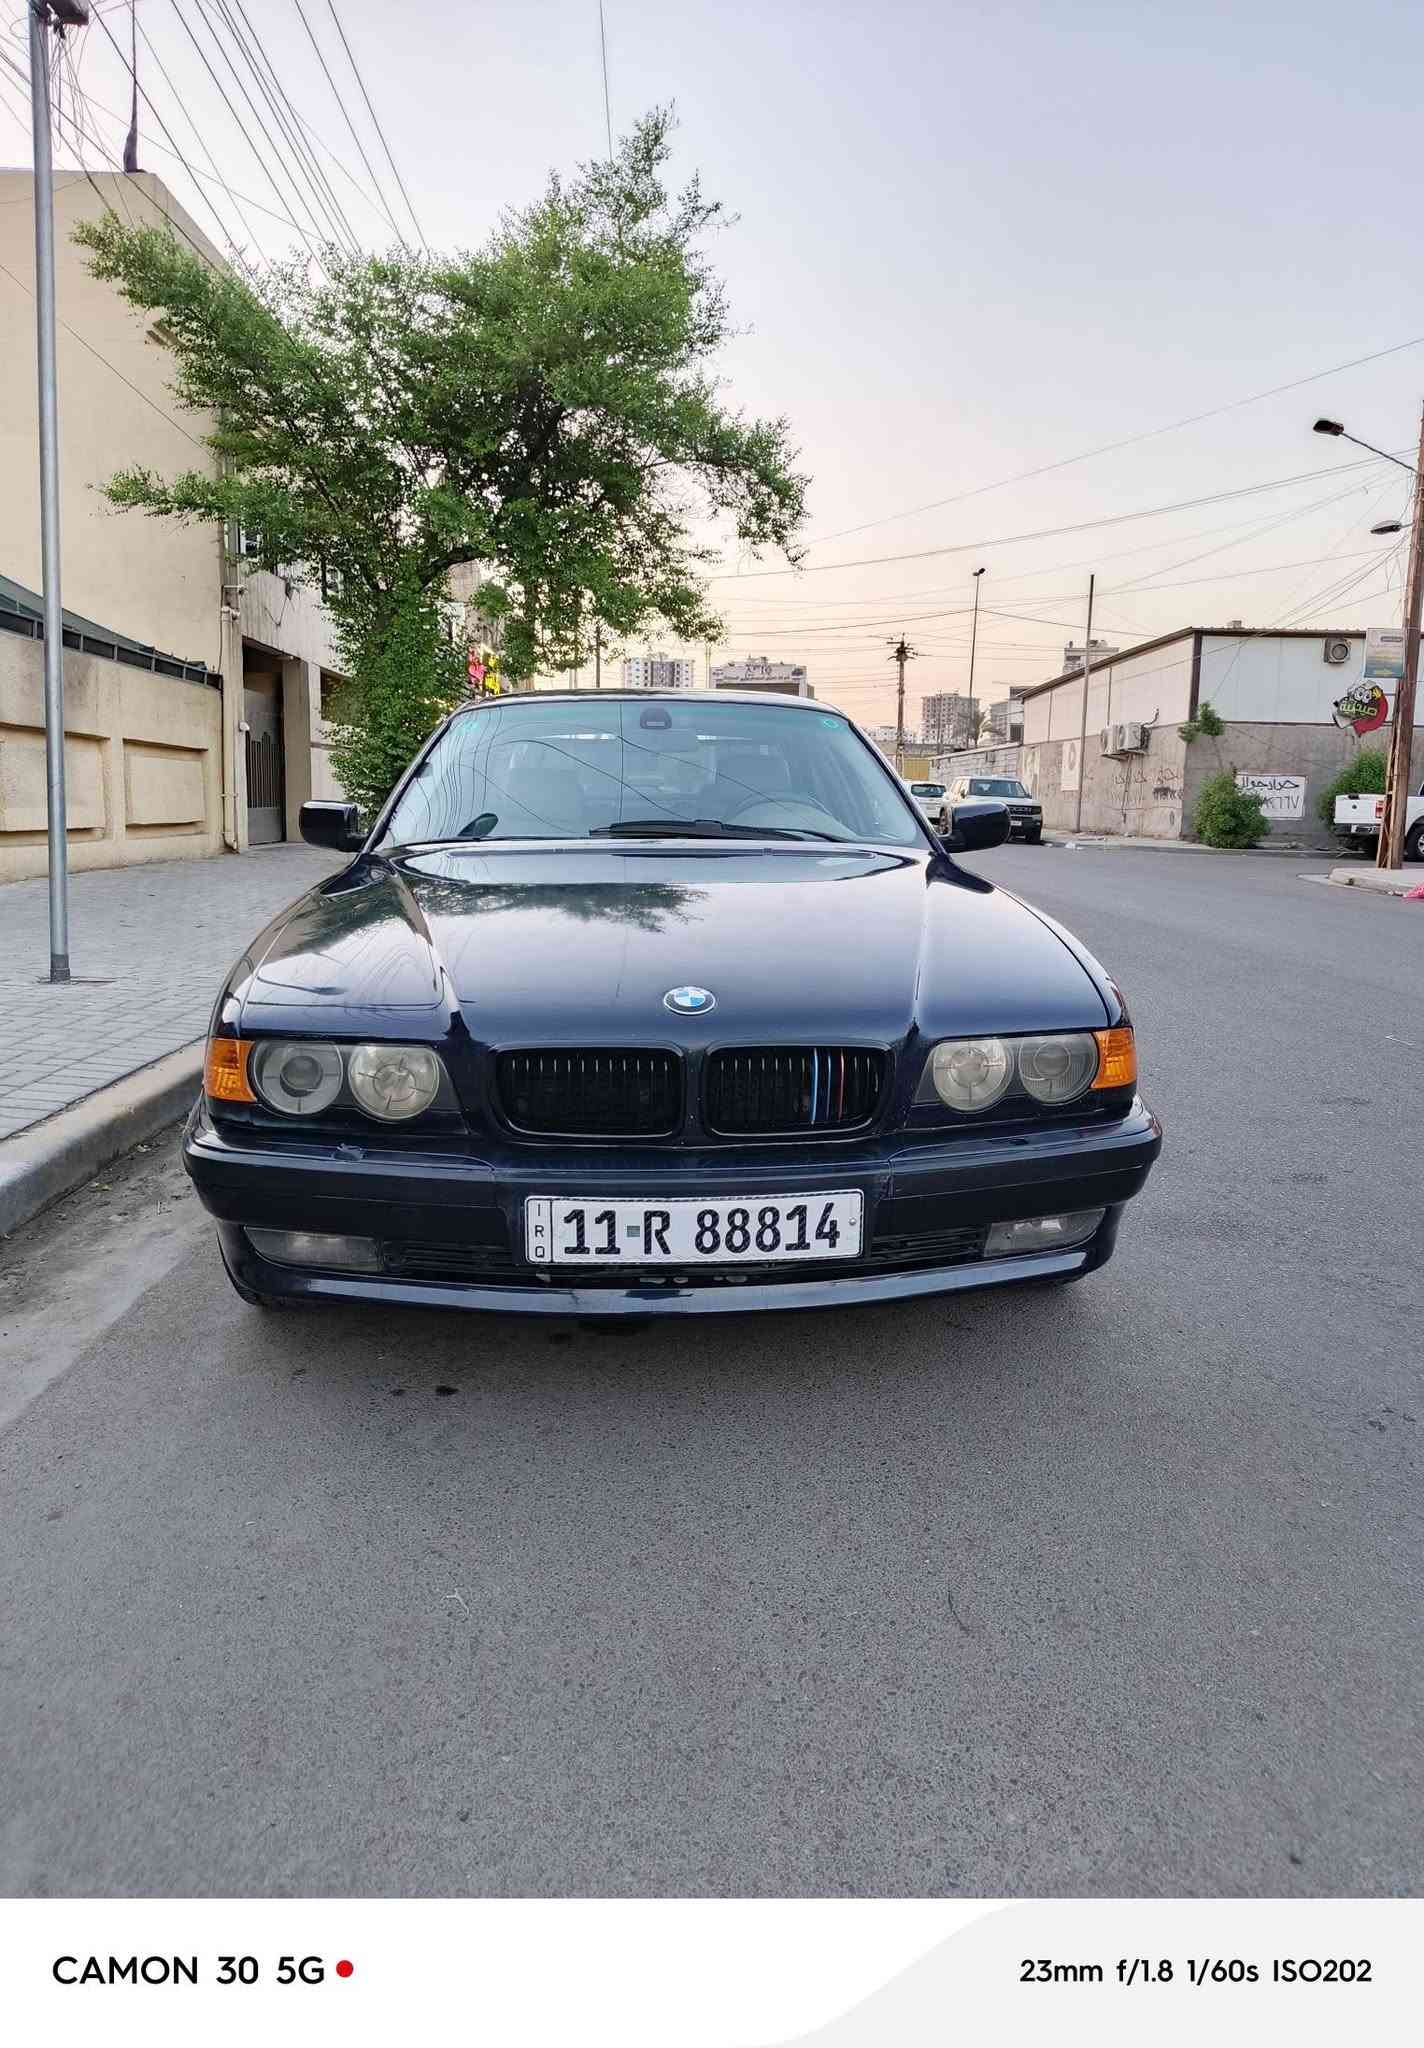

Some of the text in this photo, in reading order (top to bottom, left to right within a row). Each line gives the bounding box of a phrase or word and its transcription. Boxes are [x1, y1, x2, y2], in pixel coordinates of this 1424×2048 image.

[534, 1203, 545, 1258] IRQ
[563, 1202, 841, 1255] 11 R 88814
